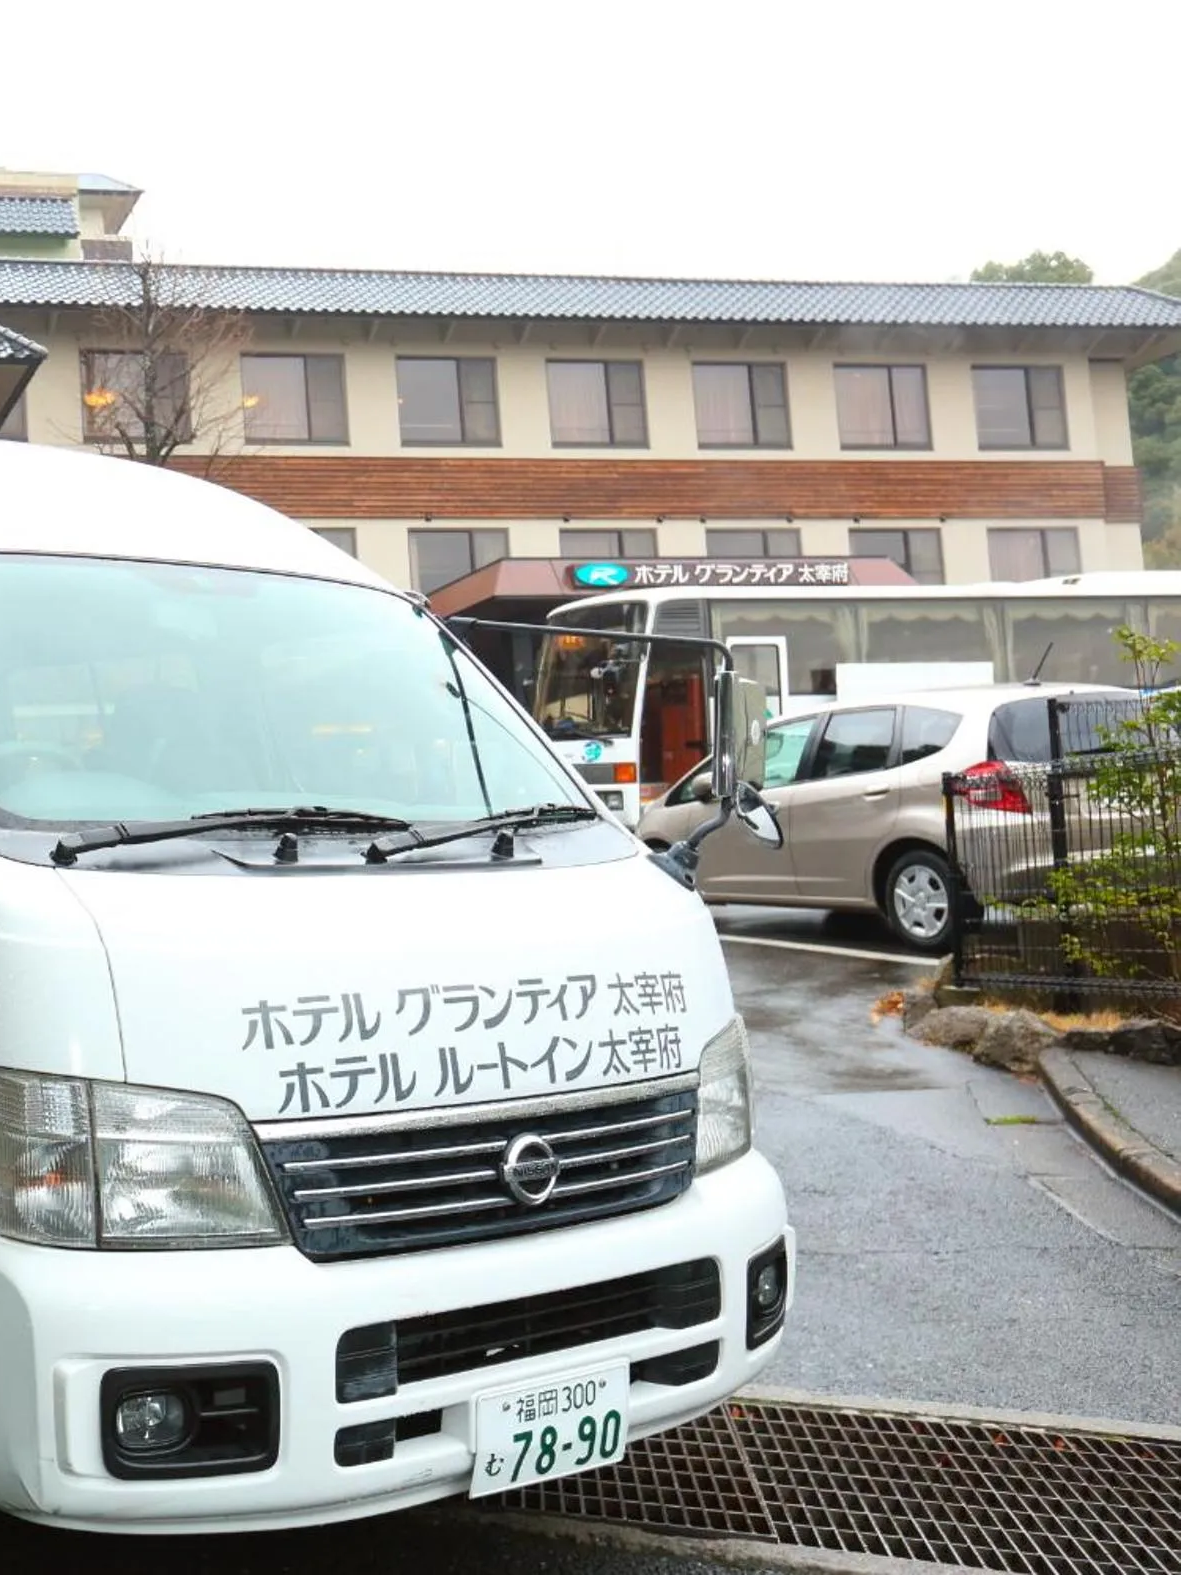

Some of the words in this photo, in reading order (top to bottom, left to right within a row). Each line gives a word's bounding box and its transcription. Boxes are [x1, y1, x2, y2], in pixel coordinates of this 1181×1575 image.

[634, 564, 689, 584] ホテル
[694, 564, 794, 584] グランティア
[798, 562, 849, 583] 太宰府
[241, 992, 381, 1051] ホテル
[395, 974, 597, 1036] グランティア
[607, 971, 688, 1017] 太宰府
[278, 1051, 417, 1114] ホテル
[510, 1409, 622, 1483] 78-90
